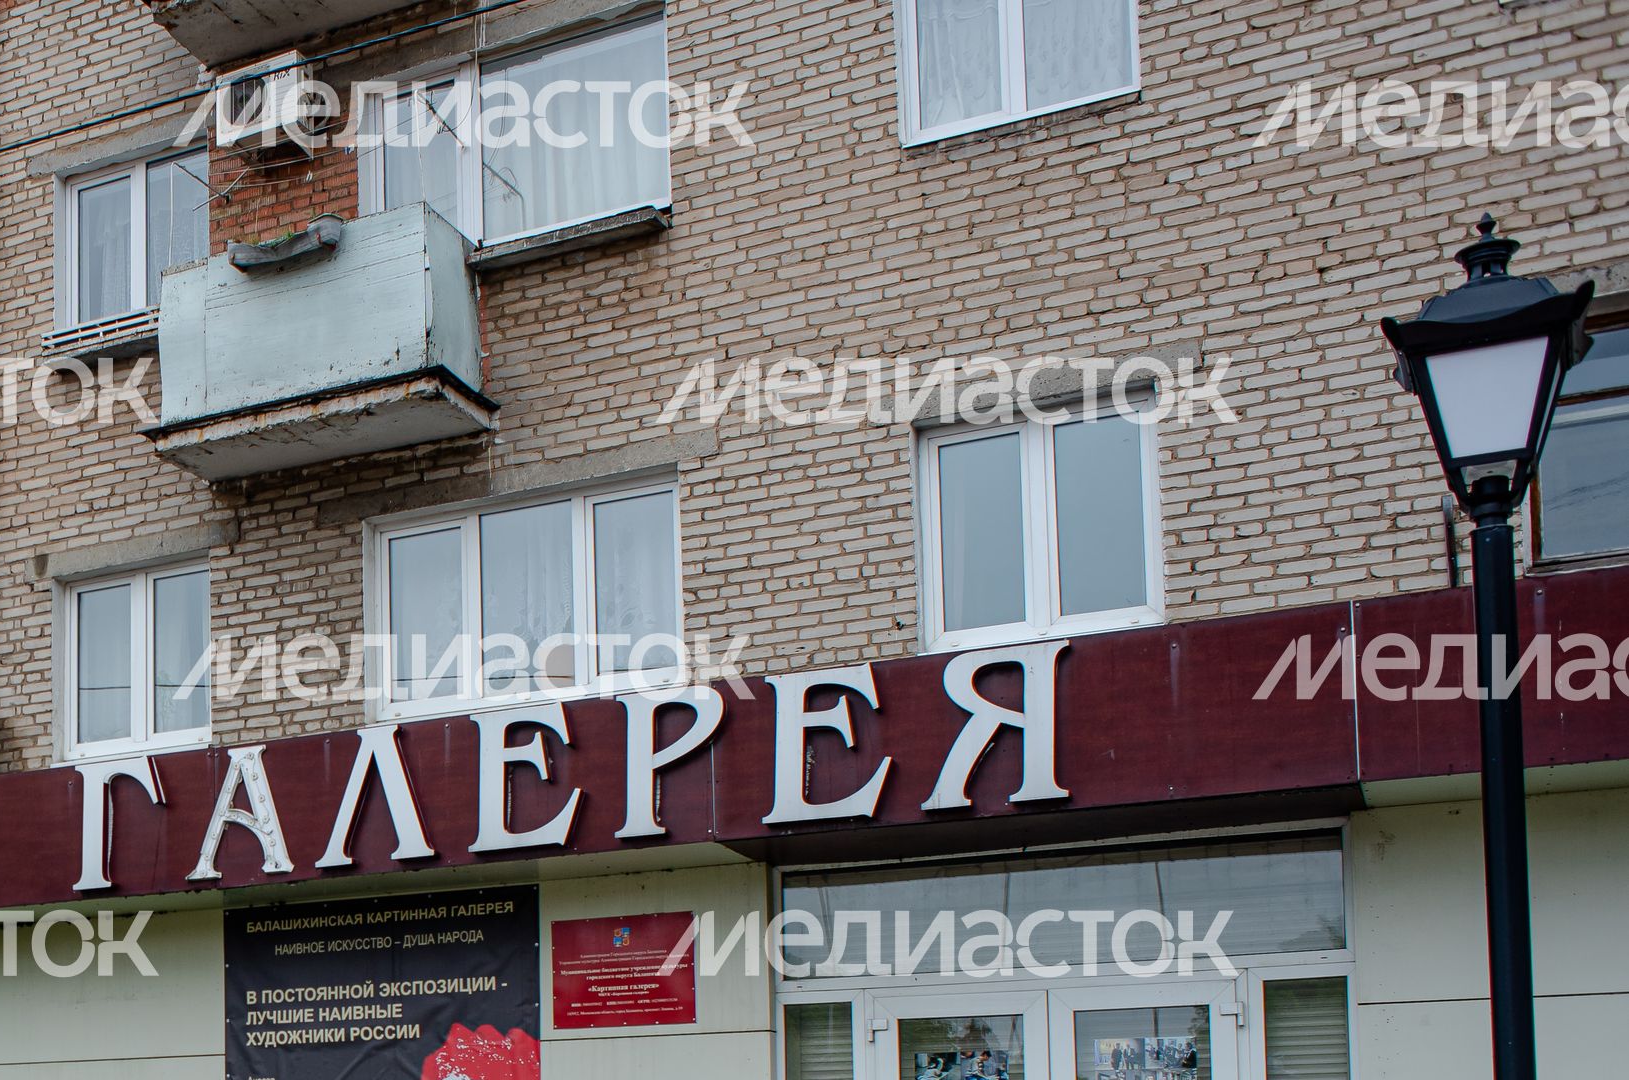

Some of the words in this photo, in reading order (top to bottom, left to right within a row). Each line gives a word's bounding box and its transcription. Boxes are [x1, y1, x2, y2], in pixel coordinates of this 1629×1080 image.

[72, 640, 1072, 893] ГАЛЕРЕЯ
[247, 914, 363, 933] БАЛАШИХИНСКАЯ
[367, 907, 447, 924] КАРТИННАЯ
[451, 901, 514, 918] ГАЛЕРЕЯ
[275, 940, 325, 956] НАИВНОЕ
[328, 936, 392, 953] ИСКУССТВО
[403, 932, 435, 949] ДУША
[437, 929, 484, 945] НАРОДА
[246, 990, 257, 1005] В
[261, 981, 375, 1005] ПОСТОЯННОЙ
[379, 975, 497, 997] ЭКСПОЗИЦИИ
[246, 1009, 315, 1026] ЛУЧШИЕ
[319, 1003, 403, 1022] НАИВНЫЕ
[246, 1029, 346, 1049] ХУДОЖНИКИ
[350, 1024, 421, 1042] РОССИИ
